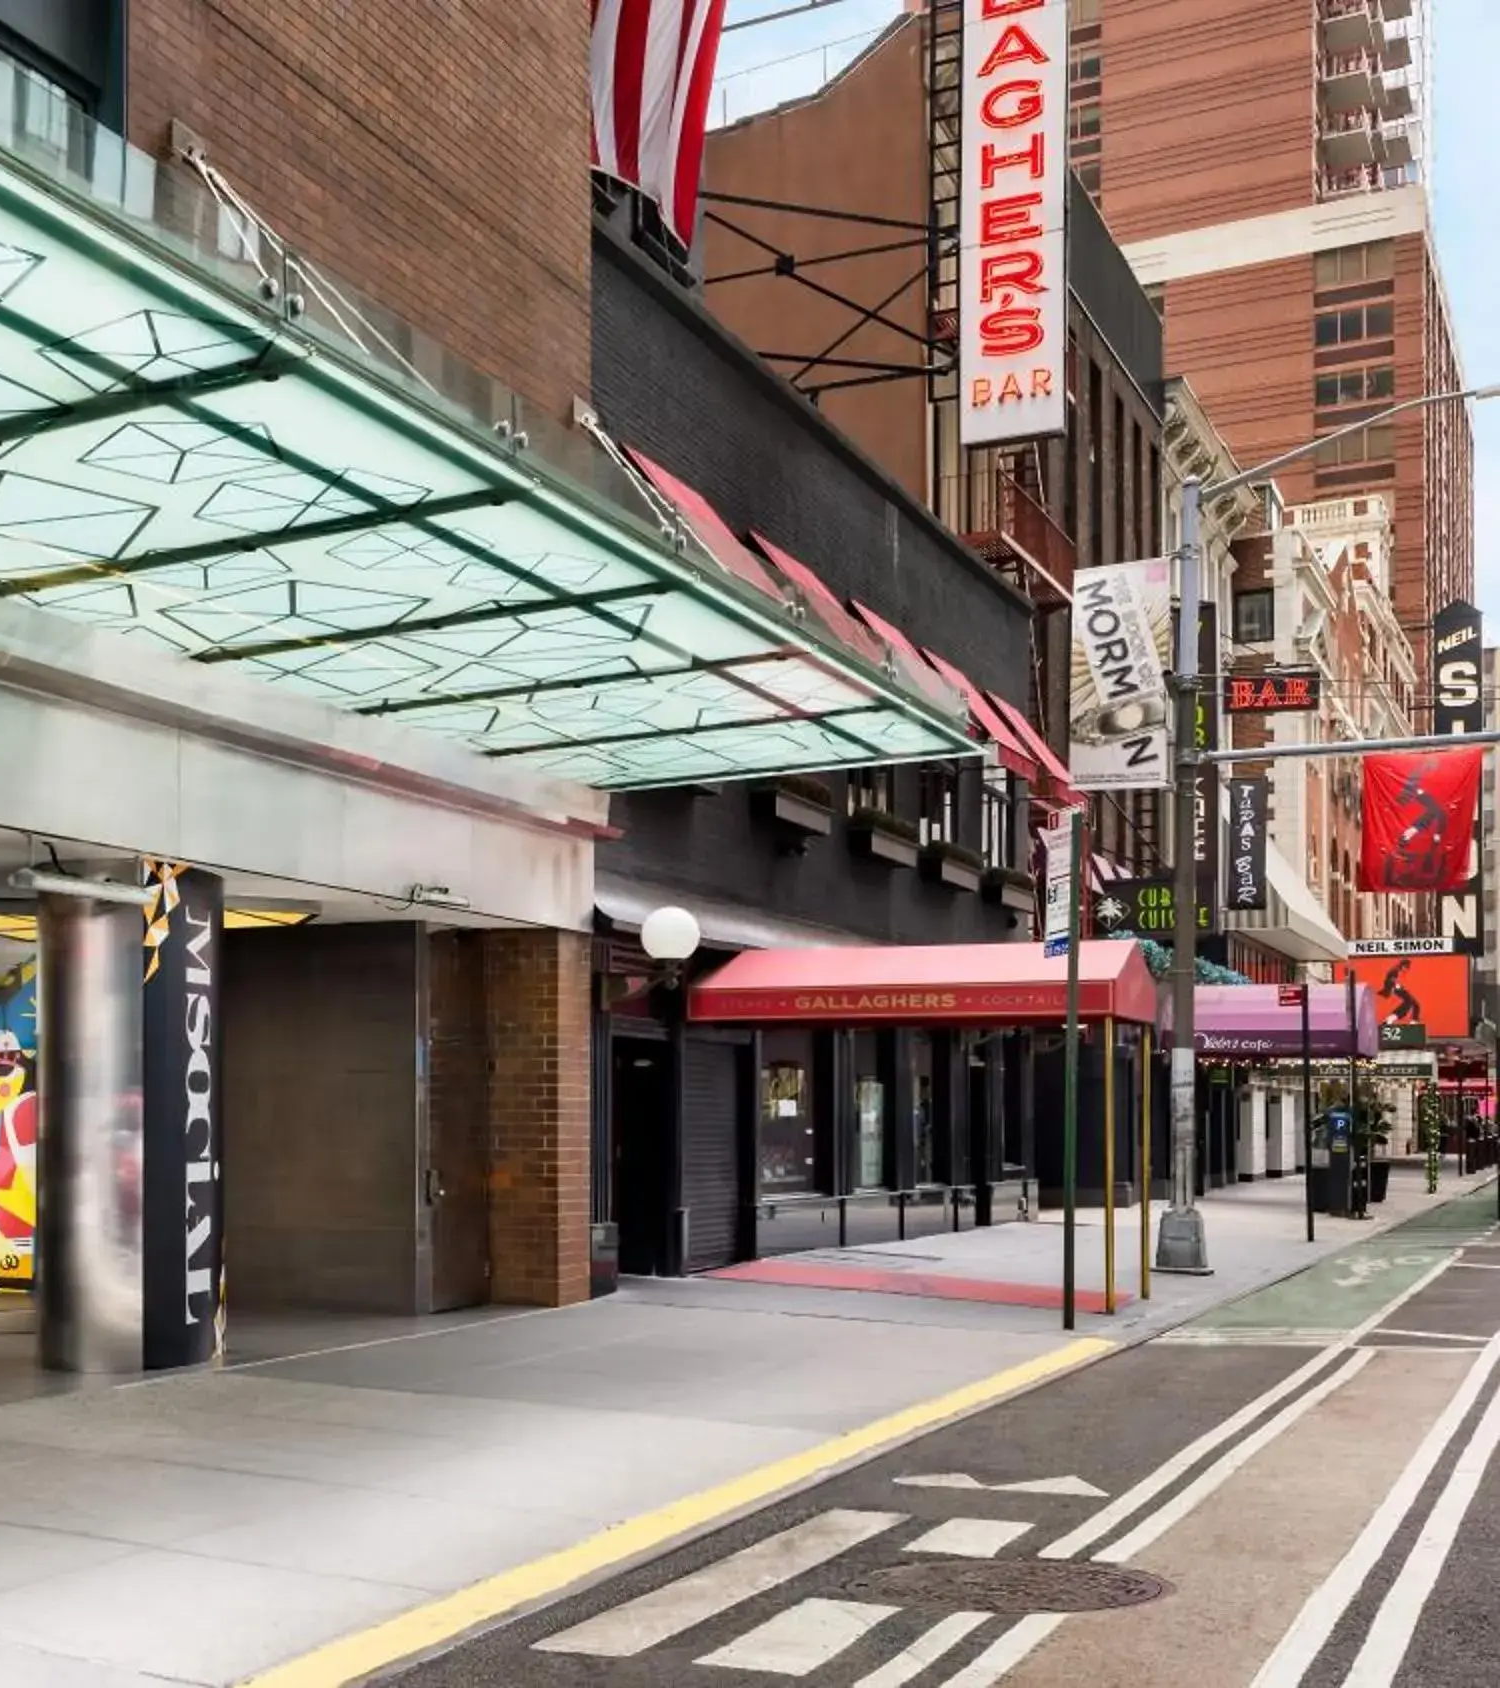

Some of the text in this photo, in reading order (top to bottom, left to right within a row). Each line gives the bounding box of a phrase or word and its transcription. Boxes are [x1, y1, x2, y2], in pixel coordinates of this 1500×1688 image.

[972, 369, 1053, 408] BAR
[1437, 626, 1478, 654] NEIL
[1230, 679, 1311, 709] BAR
[1137, 887, 1197, 907] CUB
[1137, 908, 1209, 929] CUISE
[1355, 940, 1445, 952] NEIL SIMON
[795, 992, 1066, 1009] GALLAGHERS COCKTAIL
